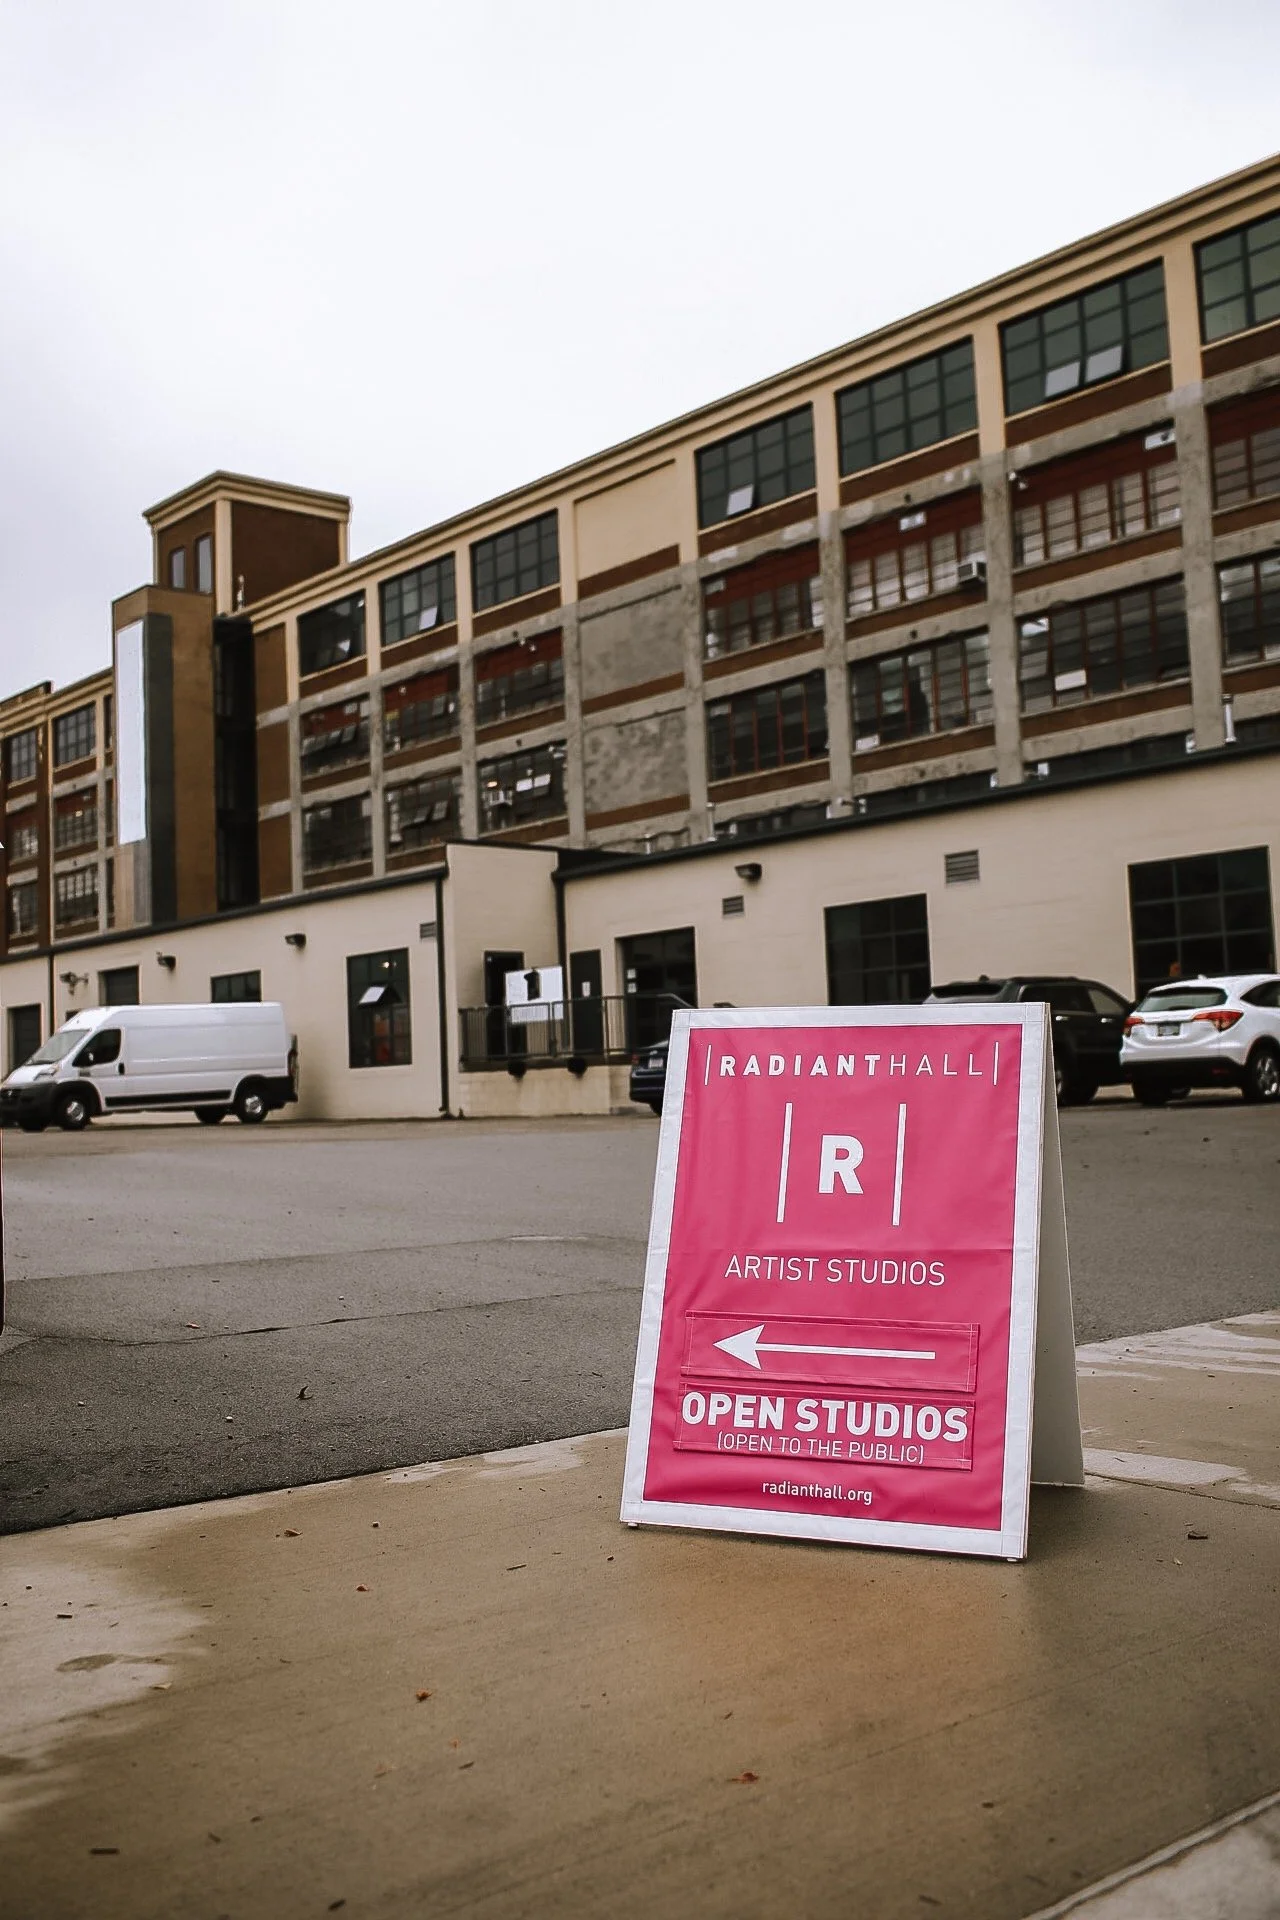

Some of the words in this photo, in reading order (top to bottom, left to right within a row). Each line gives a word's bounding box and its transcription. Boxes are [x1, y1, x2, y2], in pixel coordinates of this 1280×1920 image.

[817, 1134, 865, 1195] R
[724, 1254, 820, 1282] ARTIST
[826, 1258, 946, 1286] STUDIOS
[681, 1391, 786, 1431] OPEN
[793, 1398, 968, 1443] STUDIOS
[716, 1430, 774, 1453] (OPEN
[778, 1436, 801, 1455] TO
[806, 1438, 843, 1457] THE
[847, 1441, 925, 1465] PUBLIC)
[761, 1480, 873, 1506] radianthall.org
